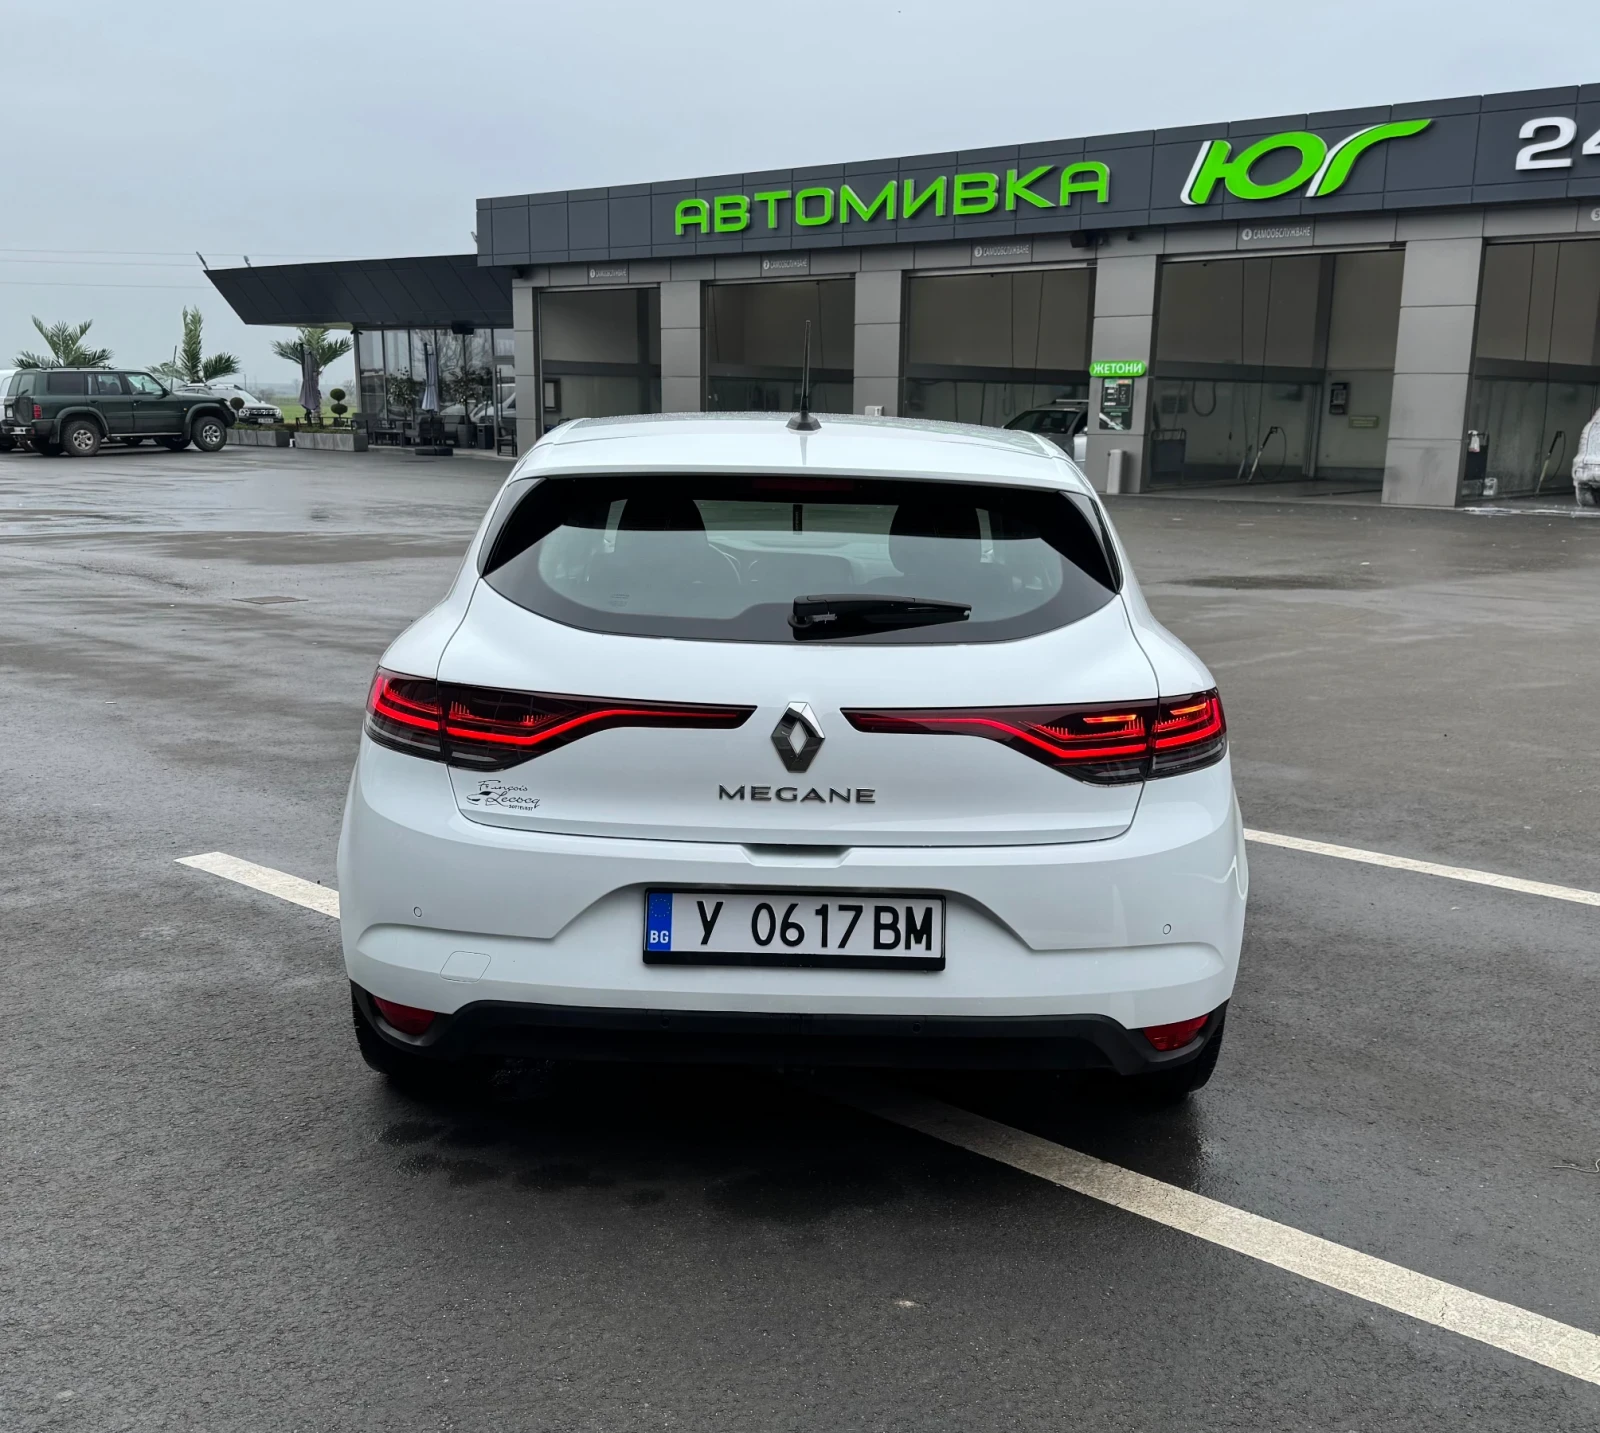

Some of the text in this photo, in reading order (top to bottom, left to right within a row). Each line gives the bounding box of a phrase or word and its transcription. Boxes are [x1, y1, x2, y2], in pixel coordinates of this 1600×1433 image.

[675, 118, 1433, 236] АВТОМИВКА ЮГ
[1093, 363, 1142, 374] ЖЕТОНИ
[719, 784, 876, 804] MEGANE
[650, 930, 669, 943] BG
